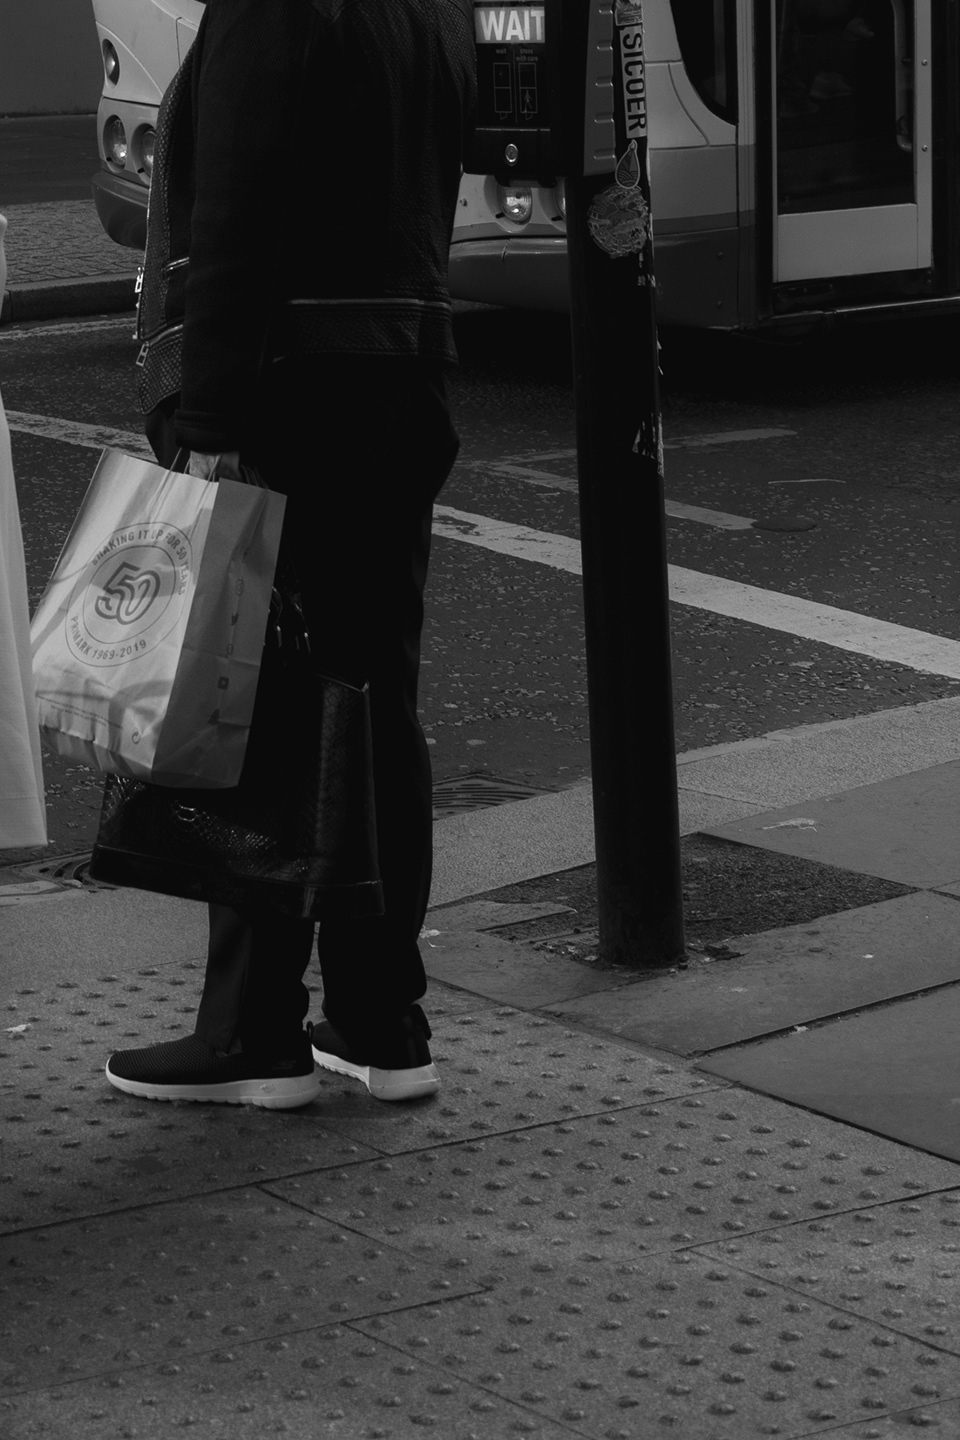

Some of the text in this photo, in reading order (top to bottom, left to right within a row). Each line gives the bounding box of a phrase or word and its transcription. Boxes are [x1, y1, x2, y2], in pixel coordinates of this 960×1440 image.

[480, 9, 545, 41] WAIT
[622, 32, 647, 133] SICOER
[91, 531, 135, 566] SHAKING
[138, 529, 149, 540] IT
[176, 545, 188, 561] 50
[94, 561, 161, 625] 50
[70, 615, 147, 660] PRIMARK 1969-2019
